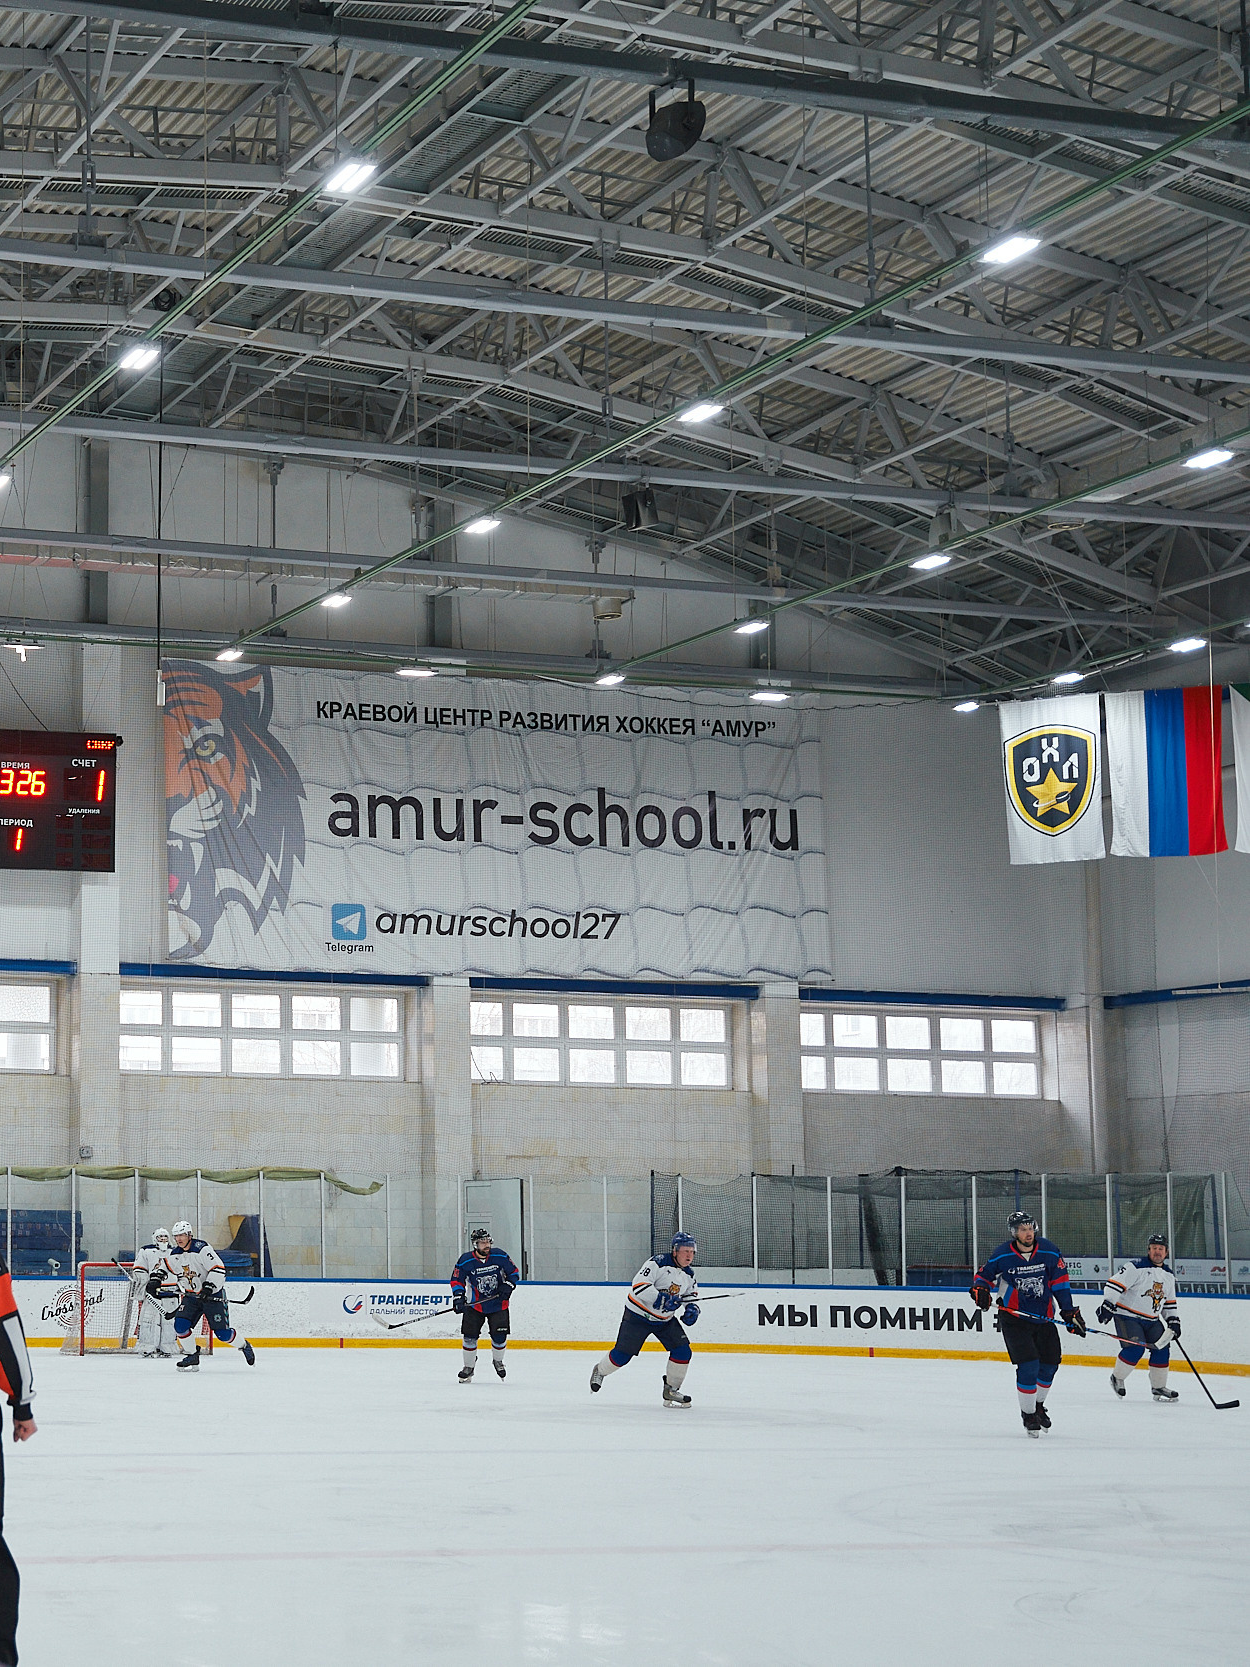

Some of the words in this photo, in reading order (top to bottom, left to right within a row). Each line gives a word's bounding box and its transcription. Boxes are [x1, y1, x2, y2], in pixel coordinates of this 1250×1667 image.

[315, 700, 418, 725] КРАЕВОЙ
[424, 705, 494, 730] ЦЕНТР
[499, 710, 610, 734] РАЗВИТИЯ
[615, 714, 695, 736] ХОККЕЯ
[0, 761, 30, 770] ВРЕМЯ
[71, 758, 97, 768] СЧЕТ
[97, 769, 106, 802] 1
[68, 807, 101, 815] УДАЛЕНИЯ
[327, 786, 800, 852] amur-school.ru
[15, 828, 23, 851] 1
[375, 908, 621, 941] amurschool27
[324, 942, 374, 955] Telegram
[369, 1294, 453, 1306] ТРАНСНЕФТ
[369, 1307, 406, 1316] ДАЛЬНИЙ
[409, 1308, 439, 1316] ВОСТОК
[758, 1303, 818, 1328] МЫ
[830, 1304, 983, 1333] ПОМНИМ
